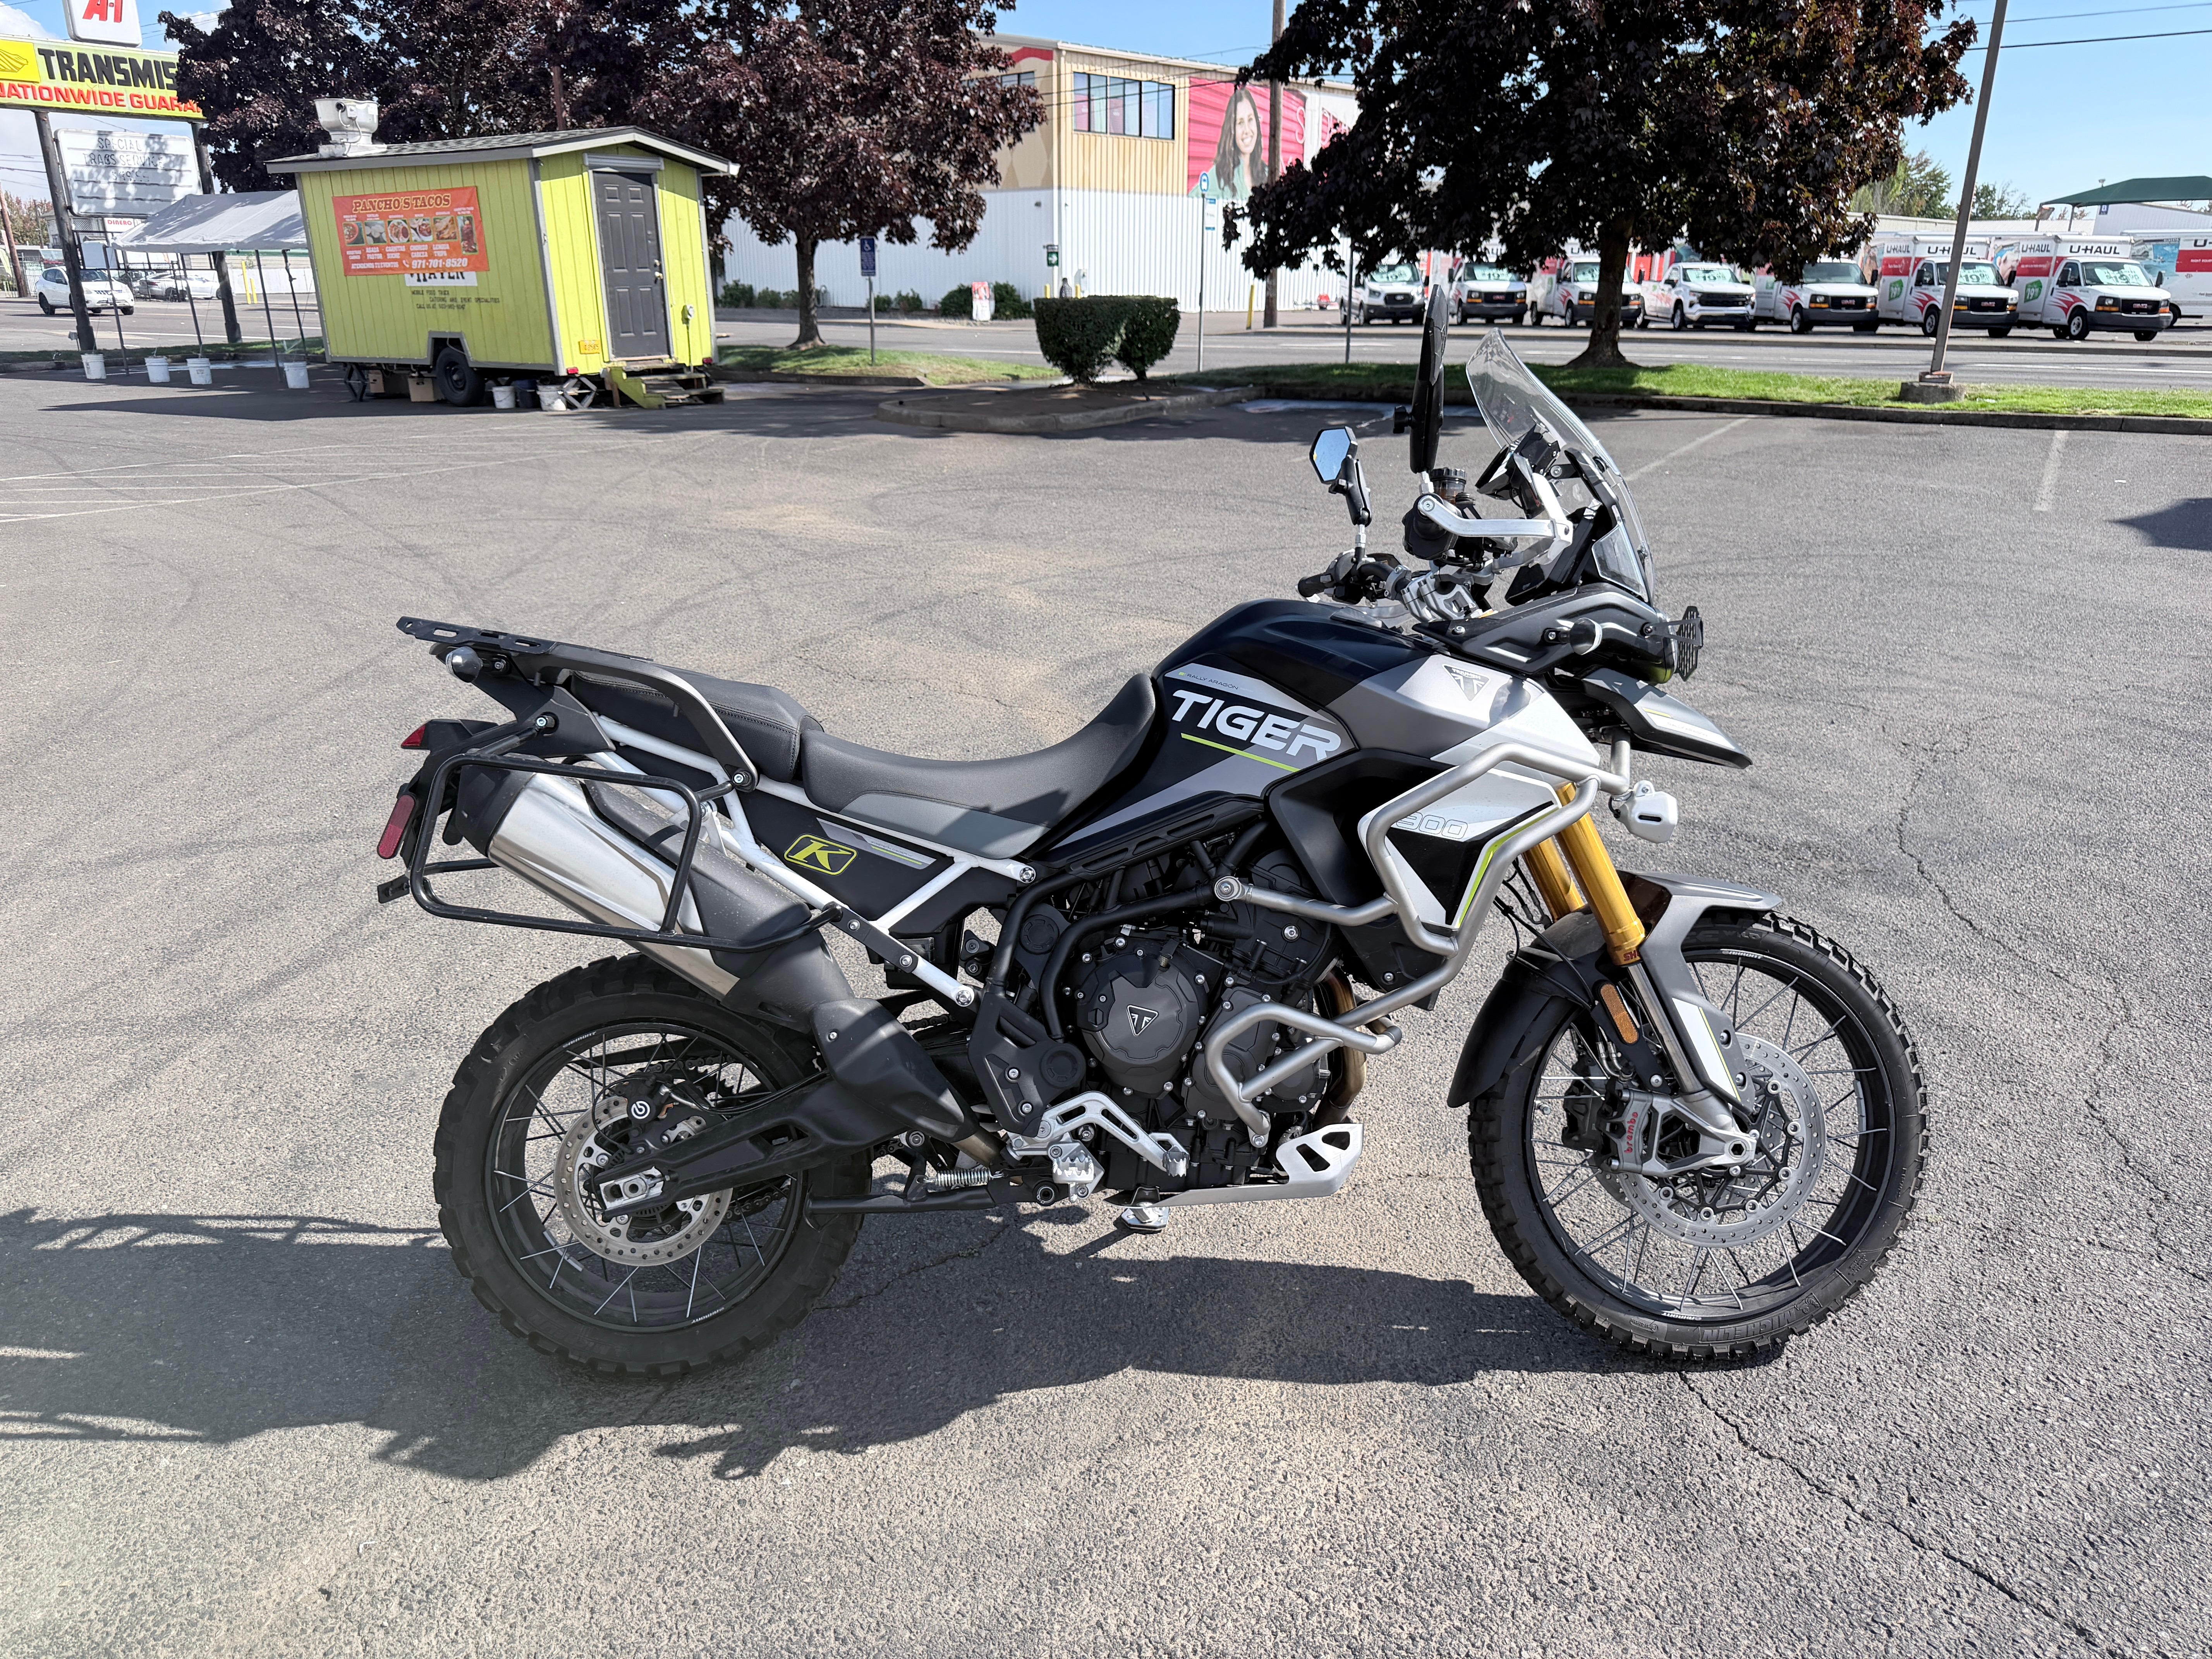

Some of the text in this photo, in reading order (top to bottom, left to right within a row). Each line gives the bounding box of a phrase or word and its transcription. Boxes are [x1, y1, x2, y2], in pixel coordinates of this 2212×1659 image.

[352, 194, 451, 213] PANCHO'S TACOS
[1886, 244, 1910, 253] U-HAUL
[1927, 246, 1977, 255] U-HL
[2021, 243, 2051, 253] U-HAUL
[2069, 245, 2120, 255] U-HAUL
[1451, 668, 1481, 680] TRIUMPH
[1208, 679, 1239, 690] ARAGÓN
[1171, 689, 1341, 761] TIGER
[1624, 1111, 1638, 1154] brembo
